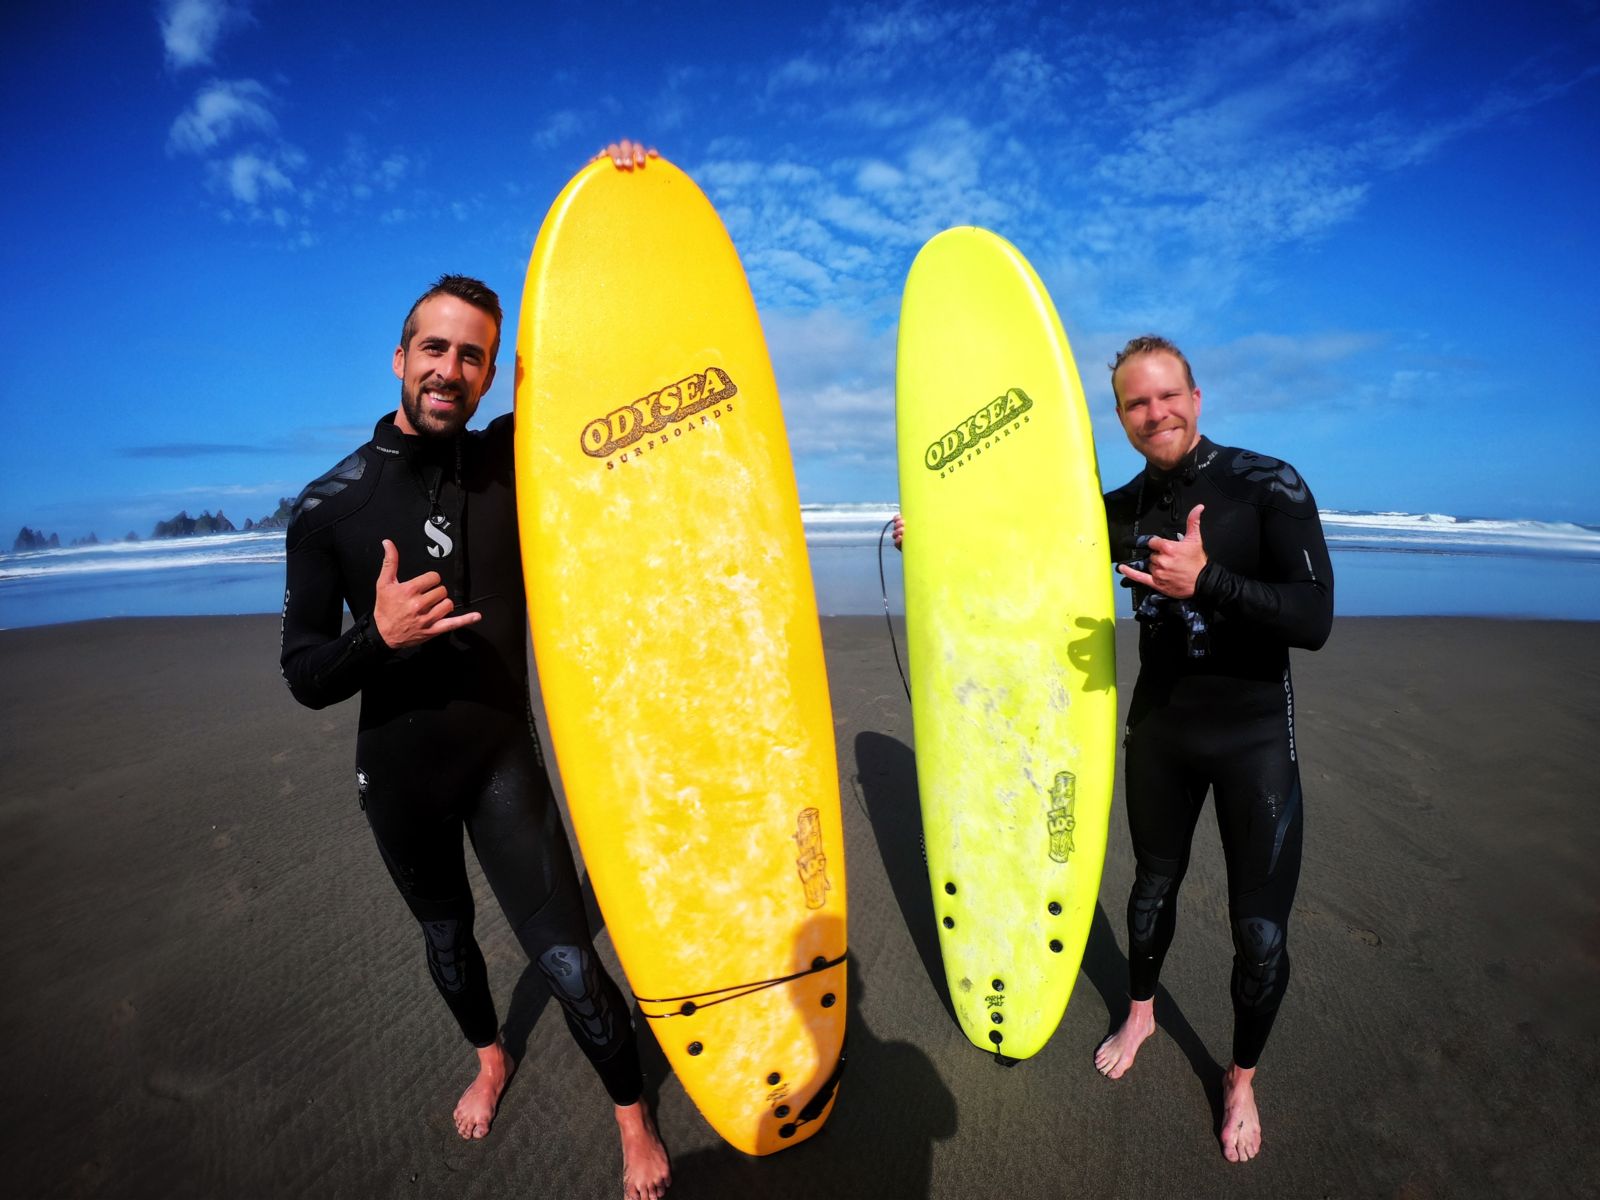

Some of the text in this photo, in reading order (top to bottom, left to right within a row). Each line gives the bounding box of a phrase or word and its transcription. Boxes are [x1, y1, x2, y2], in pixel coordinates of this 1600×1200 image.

[581, 367, 737, 458] ODYSEA
[607, 404, 733, 470] SURFBOARDS
[925, 388, 1033, 470] ODYSEA
[940, 416, 1030, 479] SURFBOARDS
